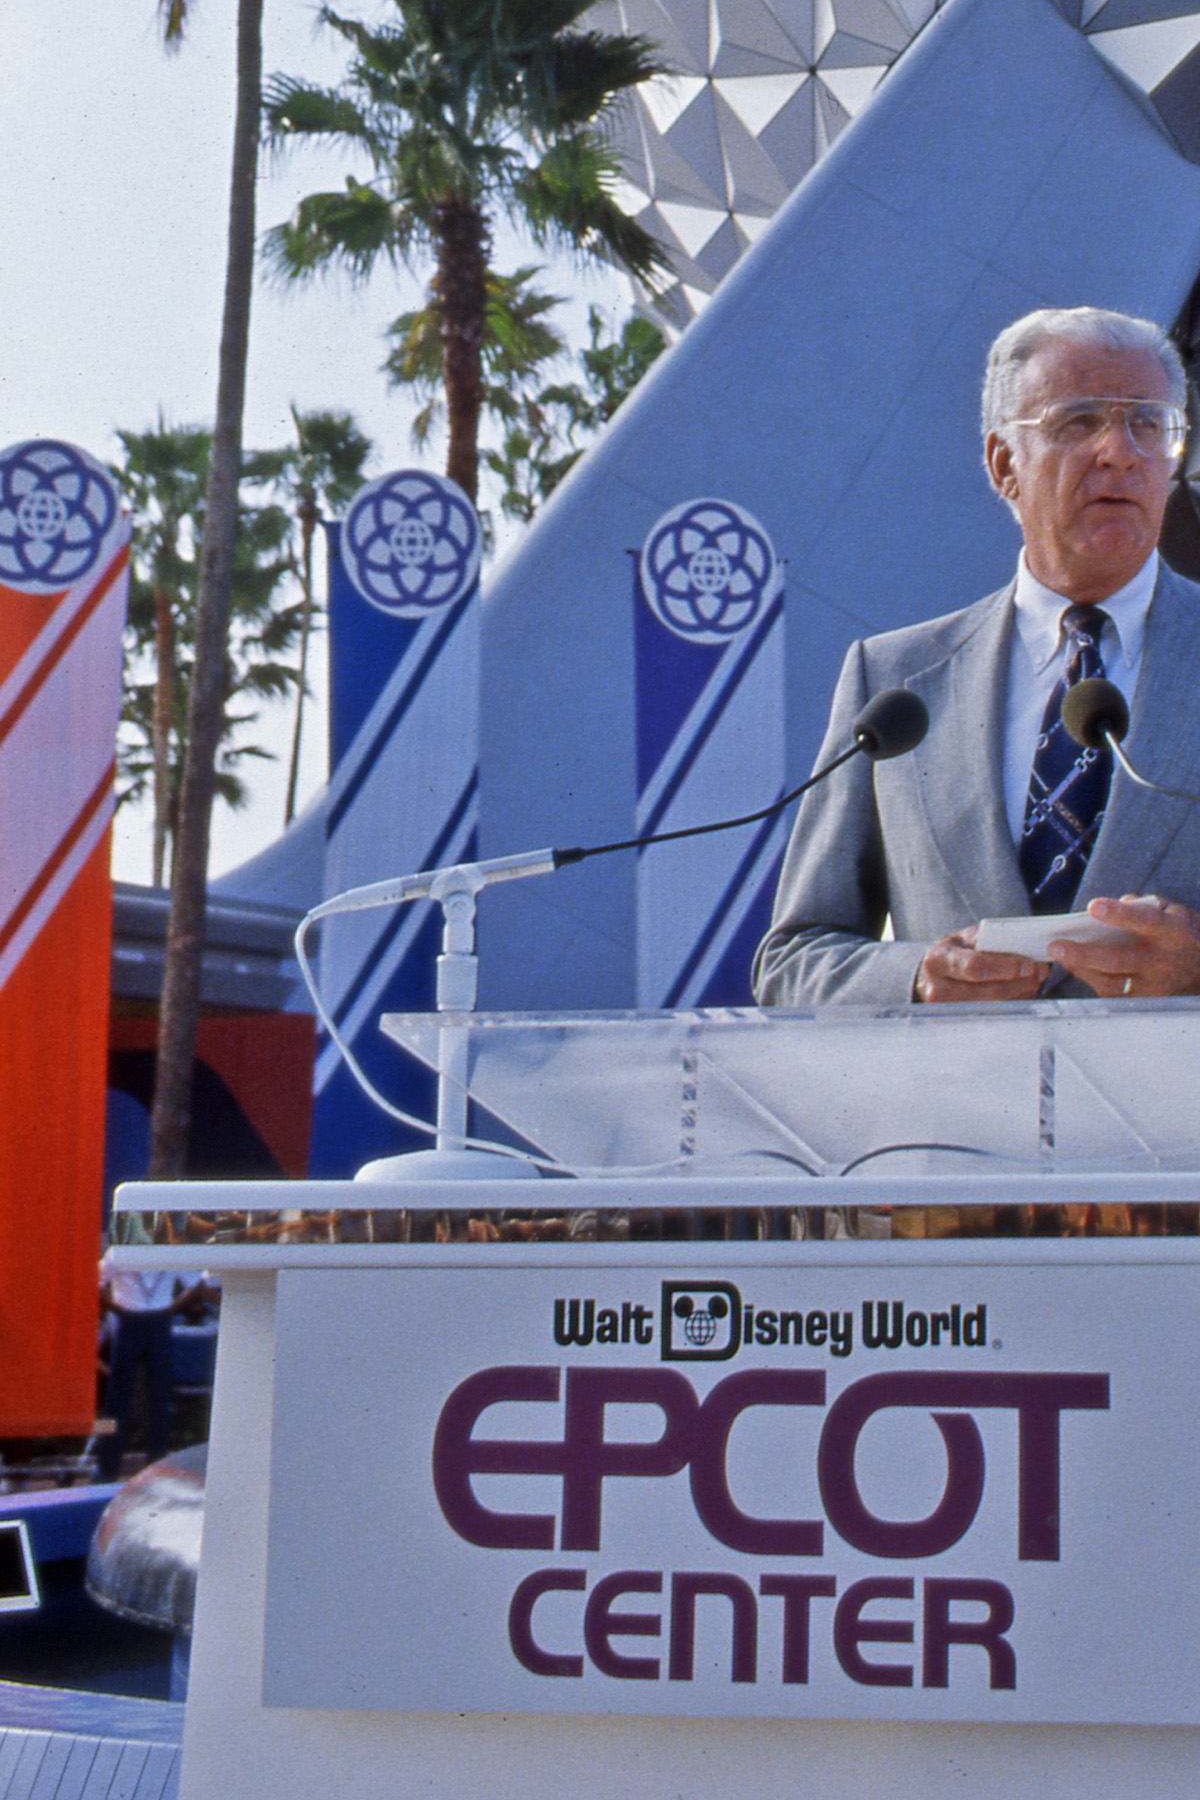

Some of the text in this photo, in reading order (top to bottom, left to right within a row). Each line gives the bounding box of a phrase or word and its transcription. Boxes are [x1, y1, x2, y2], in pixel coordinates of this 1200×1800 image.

[554, 1281, 986, 1362] Walt Disney World
[433, 1366, 1110, 1562] EPCOT
[508, 1569, 1016, 1690] CENTER
